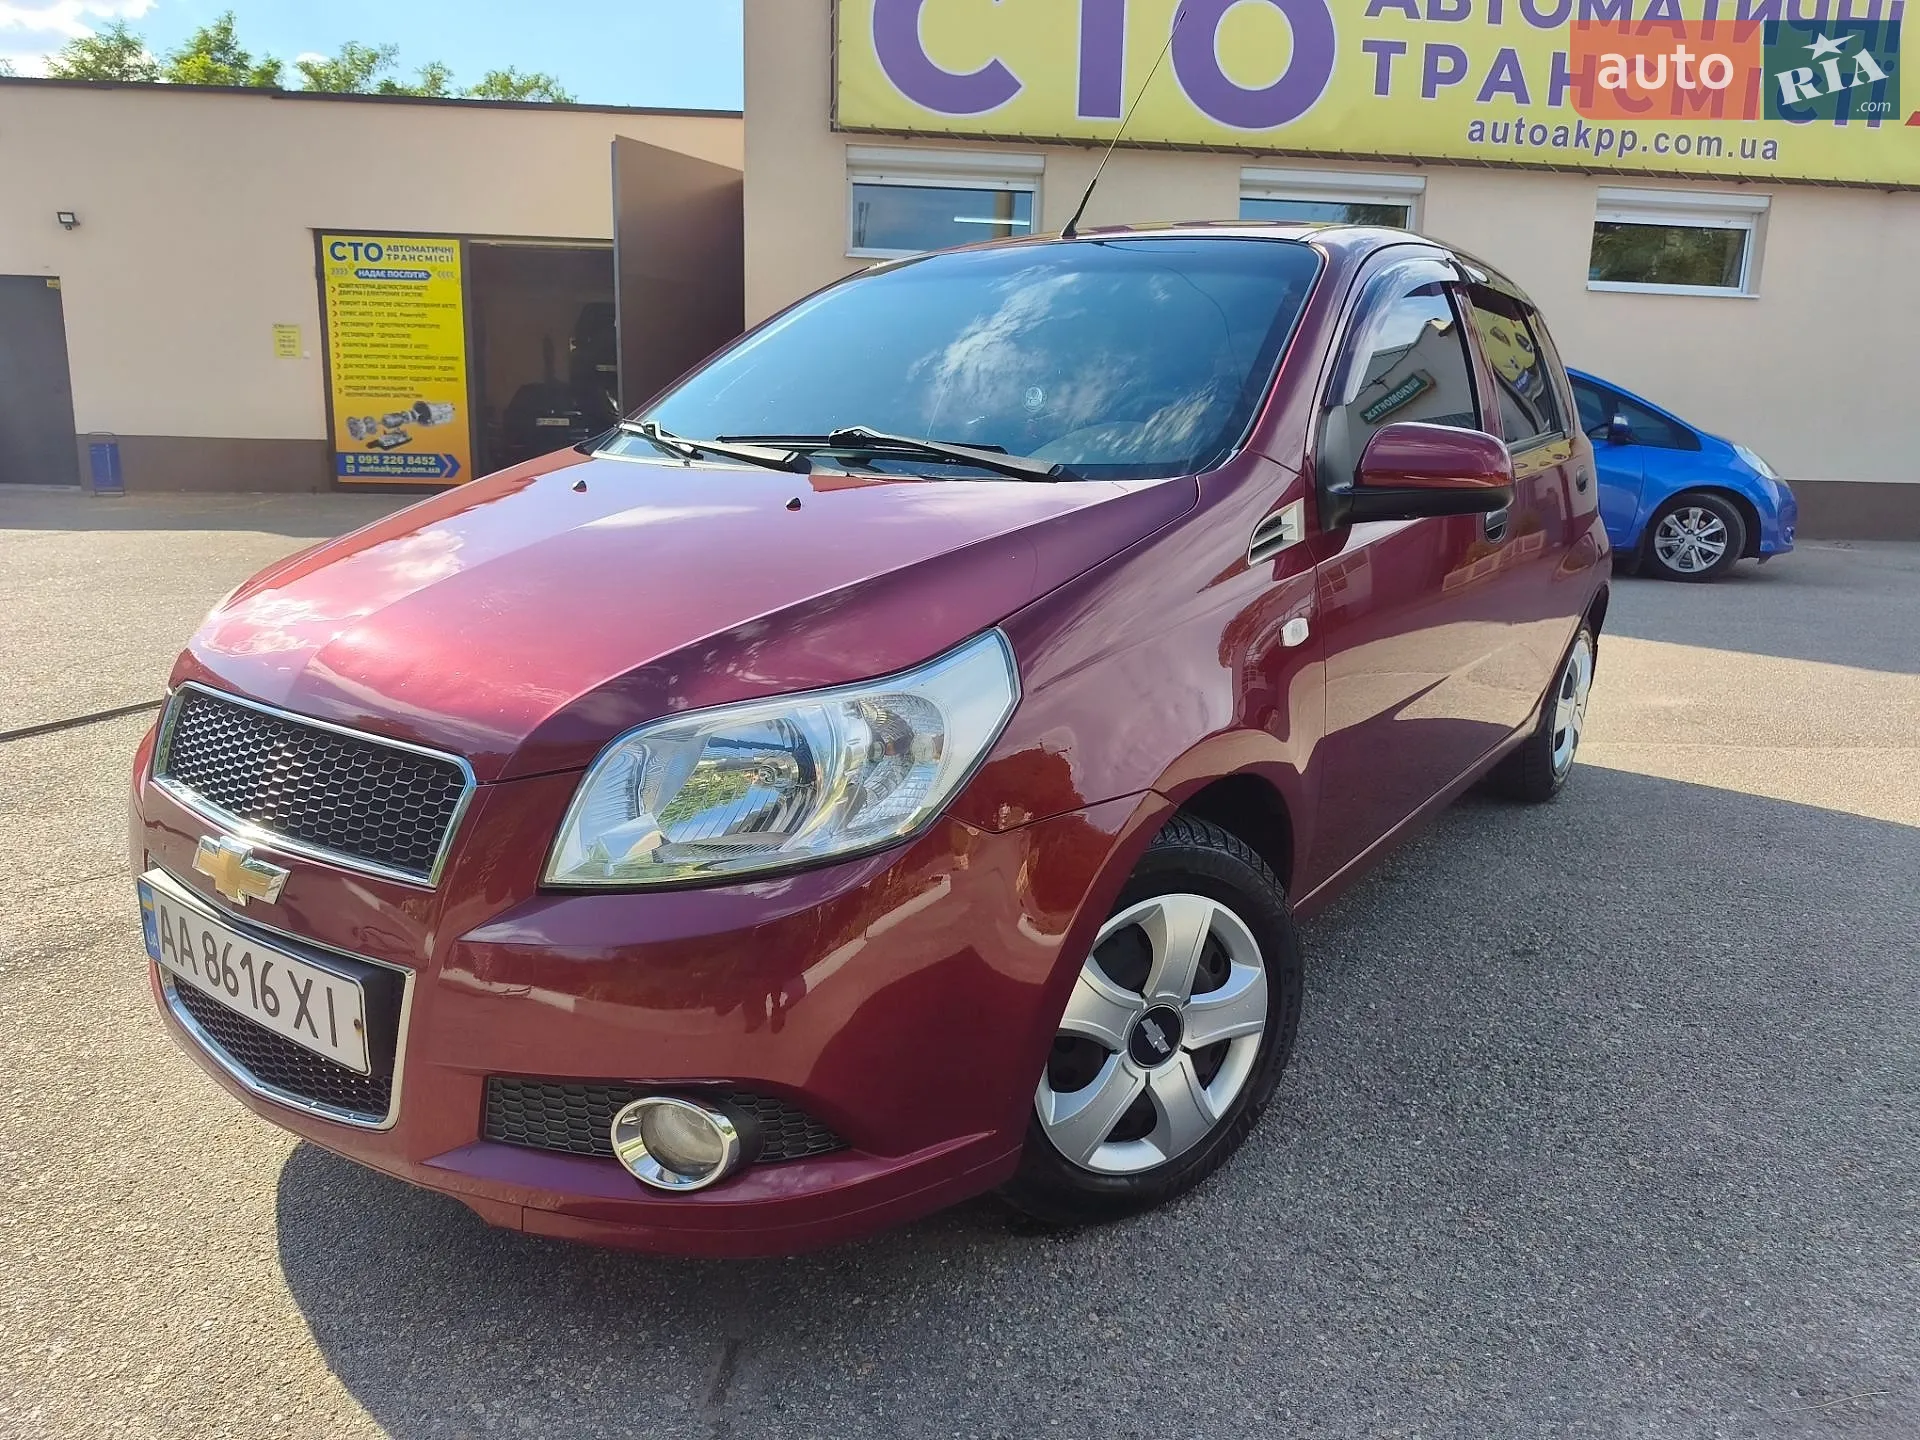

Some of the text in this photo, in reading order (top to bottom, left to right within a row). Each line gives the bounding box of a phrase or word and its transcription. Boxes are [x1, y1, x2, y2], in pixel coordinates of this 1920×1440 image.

[1467, 117, 1779, 160] autoakpp.com.ua
[330, 241, 384, 262] СТО
[386, 244, 454, 253] АВТОМАТИЧНІ
[386, 253, 454, 262] ТРАНСМІСІЇ
[358, 455, 380, 464] 095
[408, 456, 436, 465] 8452
[160, 904, 338, 1049] AA 8616 XI
